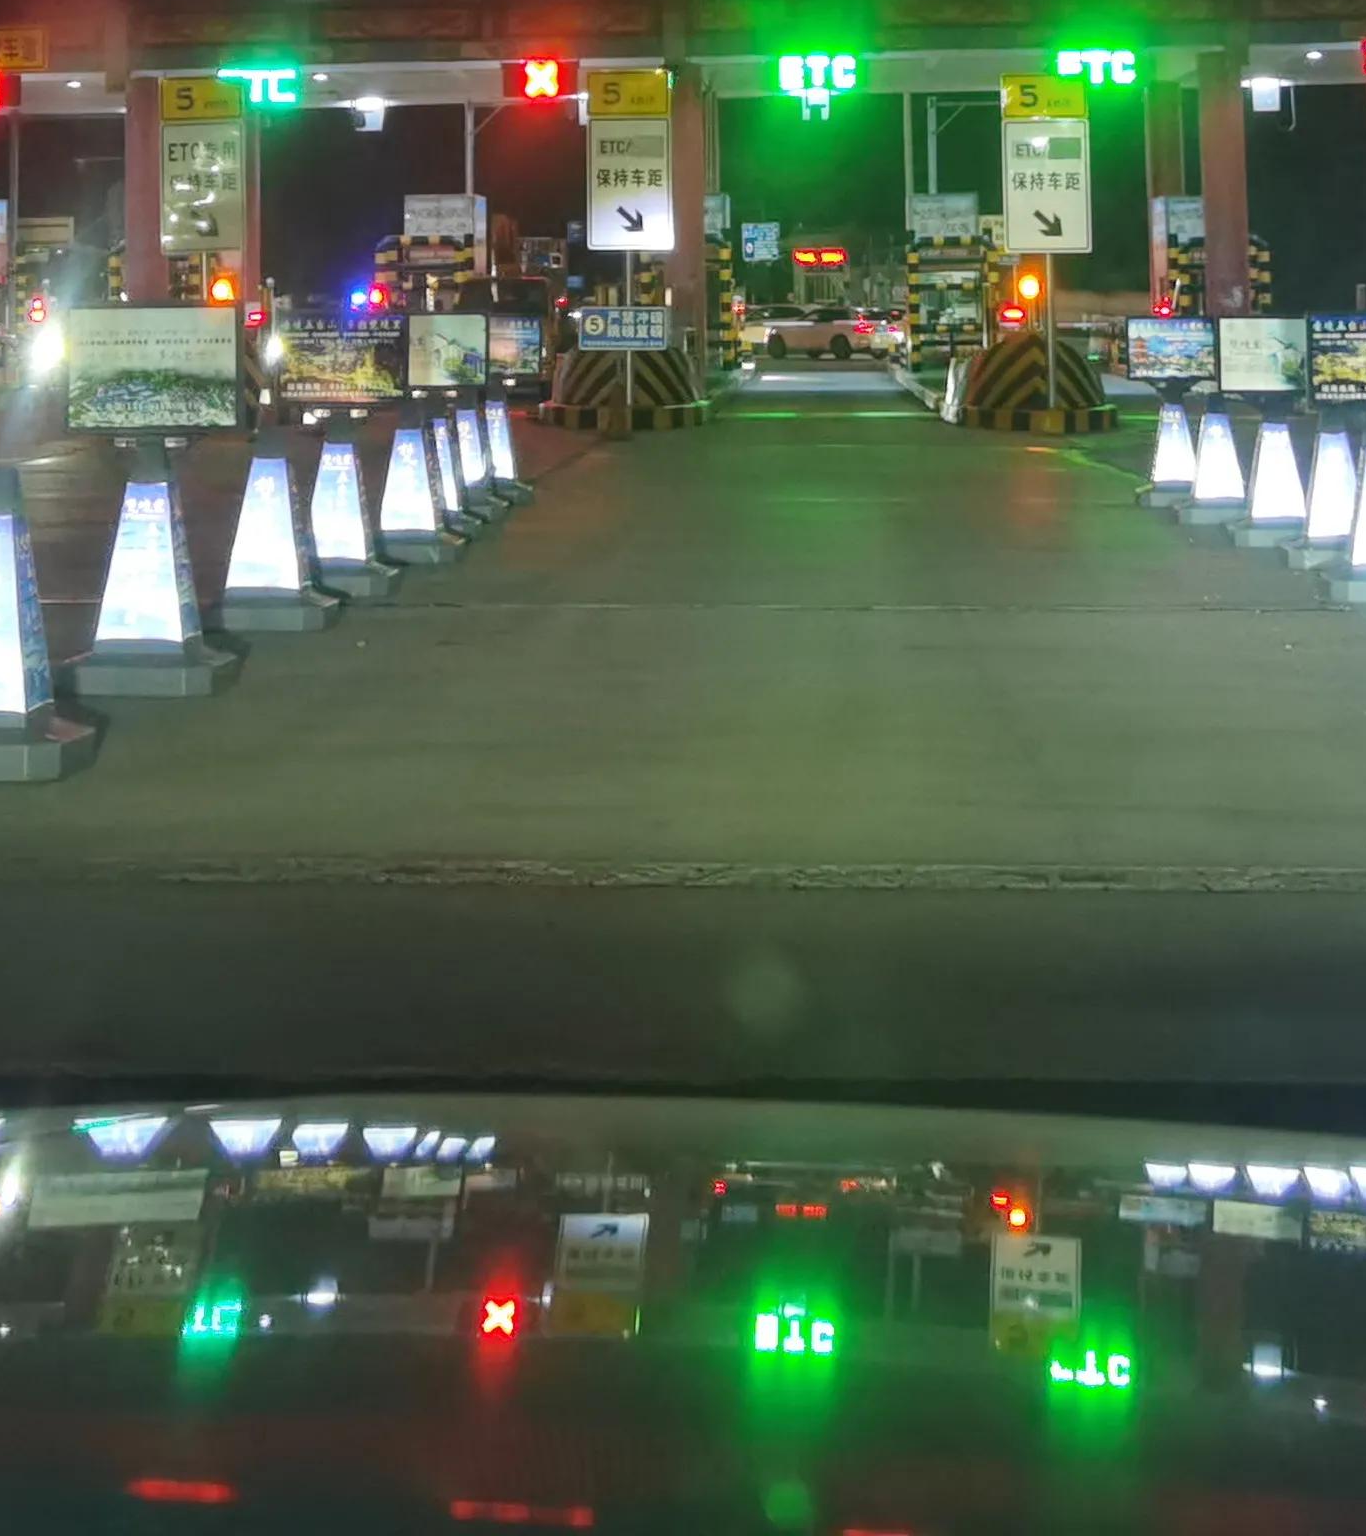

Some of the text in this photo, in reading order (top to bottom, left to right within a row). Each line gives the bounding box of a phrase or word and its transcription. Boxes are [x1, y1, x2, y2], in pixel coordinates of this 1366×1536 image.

[217, 68, 297, 103] TC
[602, 81, 622, 105] 5
[1019, 84, 1039, 108] 5
[176, 86, 195, 111] 5
[596, 168, 664, 188] 保持车距
[1011, 172, 1081, 192] 保持车距
